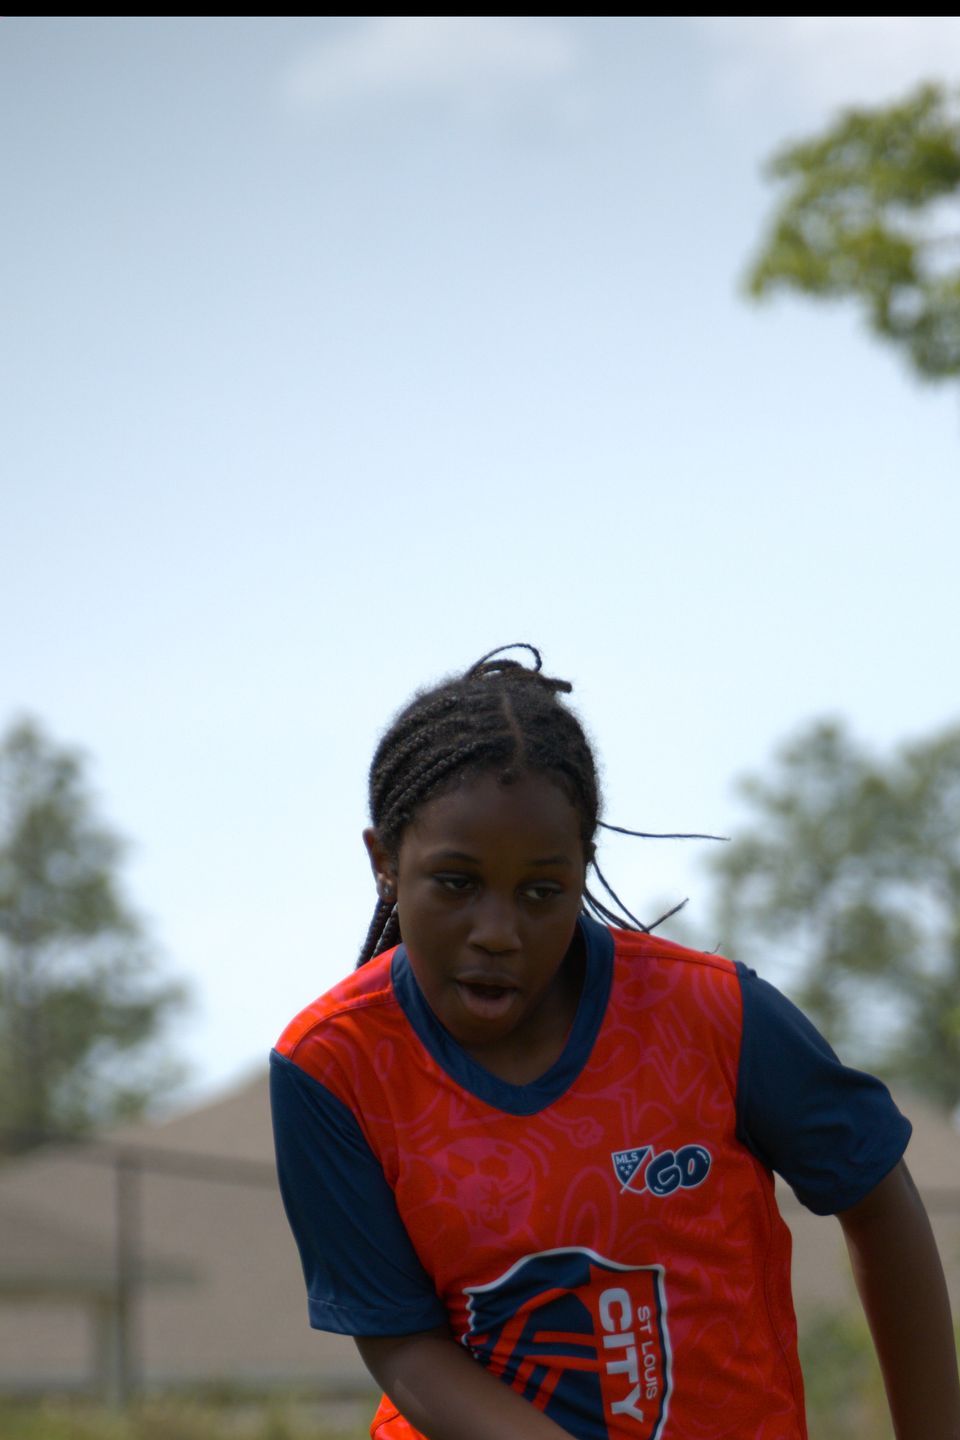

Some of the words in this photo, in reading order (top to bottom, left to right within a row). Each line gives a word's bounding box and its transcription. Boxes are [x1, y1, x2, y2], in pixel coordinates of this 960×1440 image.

[615, 1152, 639, 1165] MLS
[645, 1144, 712, 1197] GO
[638, 1305, 652, 1334] ST
[599, 1288, 644, 1423] CITY
[641, 1341, 658, 1399] LOUIS
